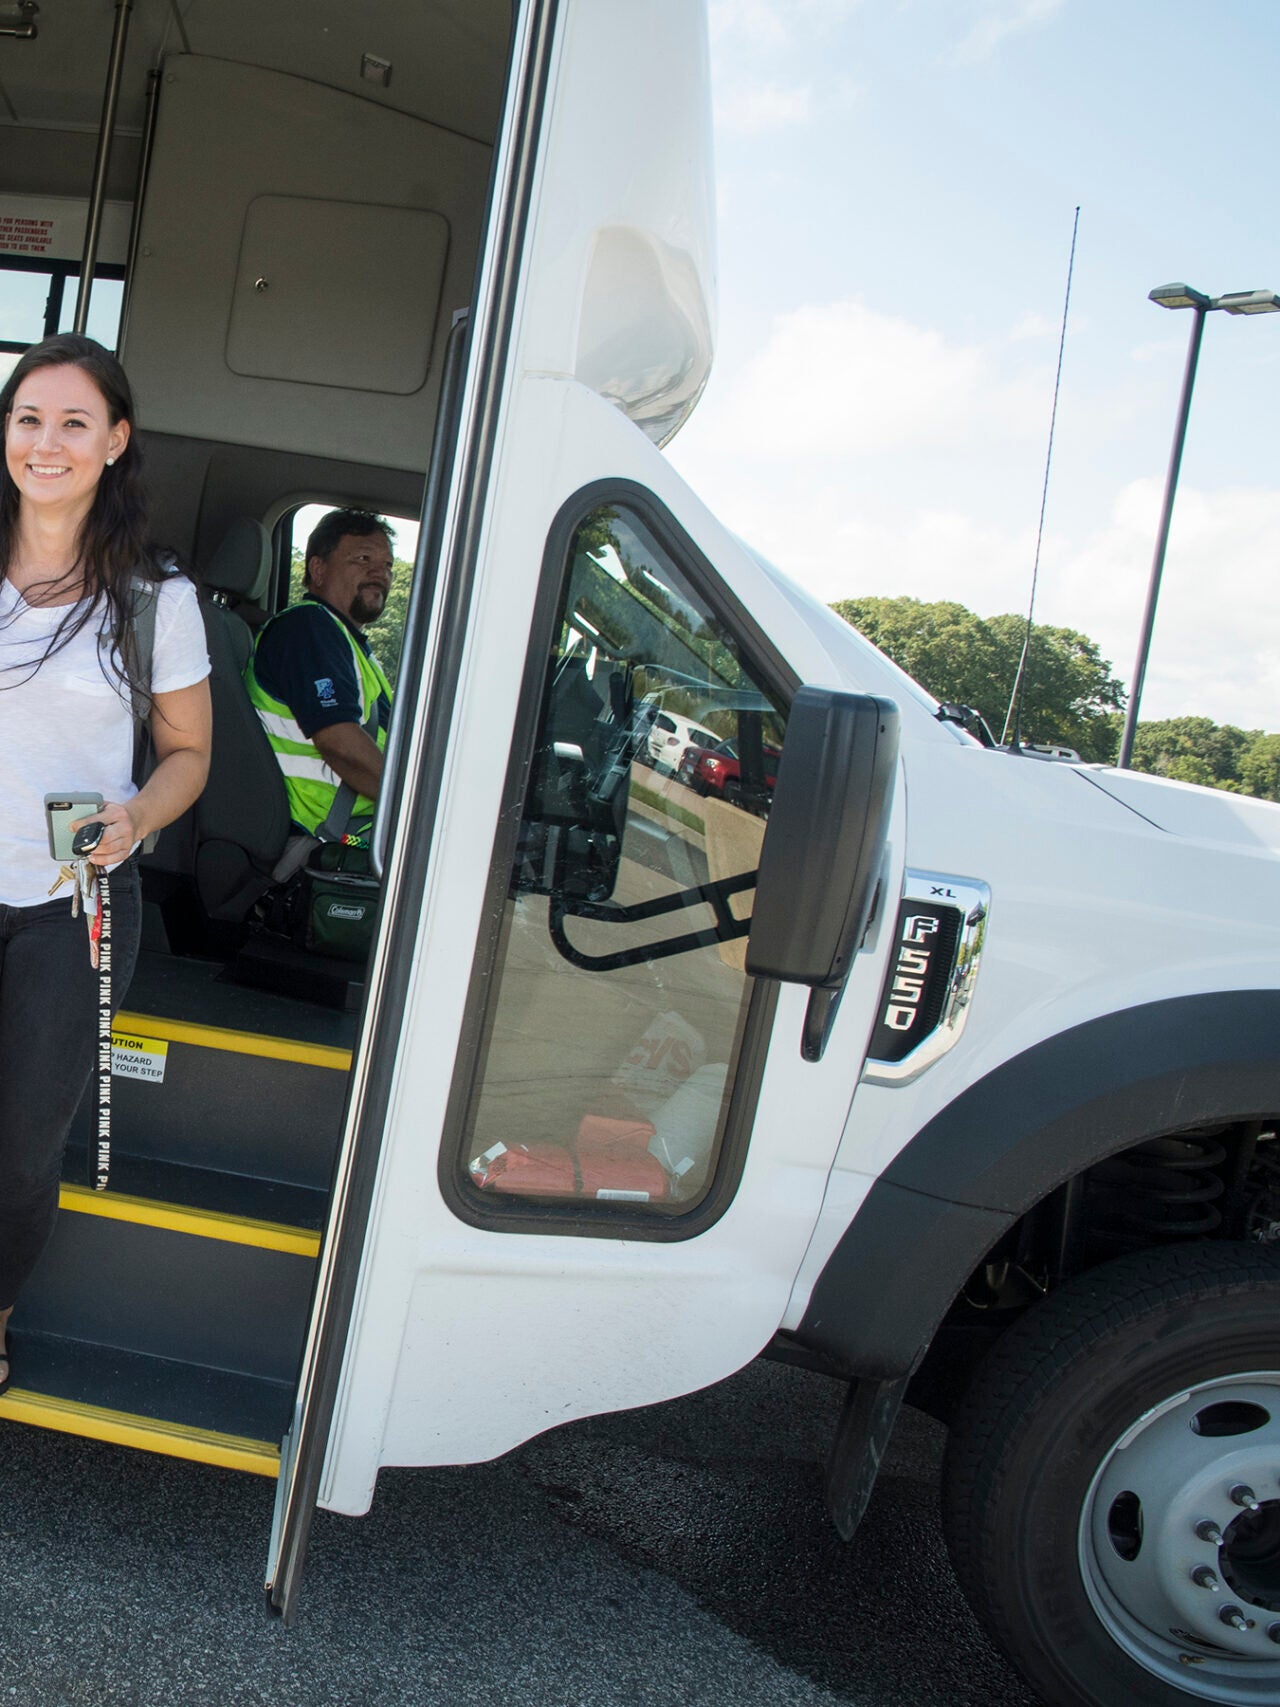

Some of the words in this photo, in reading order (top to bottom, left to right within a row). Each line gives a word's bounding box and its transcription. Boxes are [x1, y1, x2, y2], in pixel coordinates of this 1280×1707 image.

[15, 219, 38, 227] PERSONS
[40, 220, 53, 228] WITH
[15, 227, 48, 235] PASSENGERS
[7, 234, 23, 242] SEATS
[25, 236, 52, 245] AVAILABLE
[99, 877, 110, 906] PINK
[930, 886, 957, 898] XL
[102, 910, 111, 939] PINK
[99, 943, 111, 972] PINK
[884, 915, 939, 1031] F550
[99, 976, 111, 1005] PINK
[99, 1009, 111, 1038] PINK
[99, 1042, 111, 1071] PINK
[111, 1037, 143, 1050] UTION
[115, 1063, 139, 1073] YOUR
[141, 1067, 163, 1078] STEP
[116, 1053, 152, 1066] HAZARD
[99, 1075, 111, 1104] PINK
[99, 1108, 111, 1137] PINK
[98, 1141, 110, 1171] PINK
